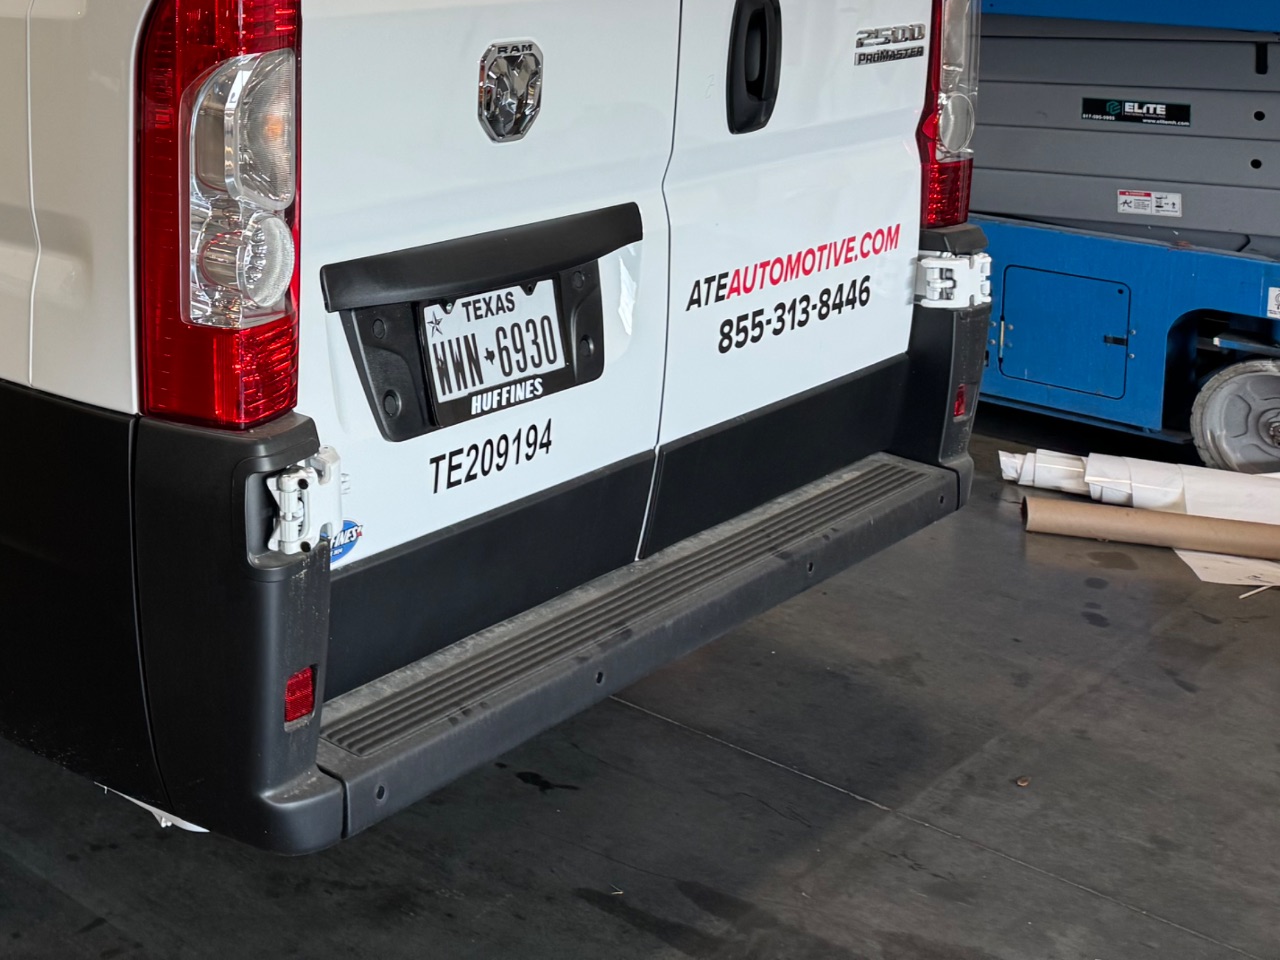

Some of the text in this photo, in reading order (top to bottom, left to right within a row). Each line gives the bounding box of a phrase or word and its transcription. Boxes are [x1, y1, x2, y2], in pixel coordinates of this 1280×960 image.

[497, 44, 533, 55] RAM
[855, 24, 926, 48] 2500
[1125, 102, 1166, 115] ELITE
[686, 224, 901, 311] ATEAUTOMOTIVE.COM
[461, 291, 515, 322] TEXAS
[719, 275, 871, 354] 855-313-8446
[471, 378, 543, 415] HUFFINES
[429, 418, 552, 494] TE209194
